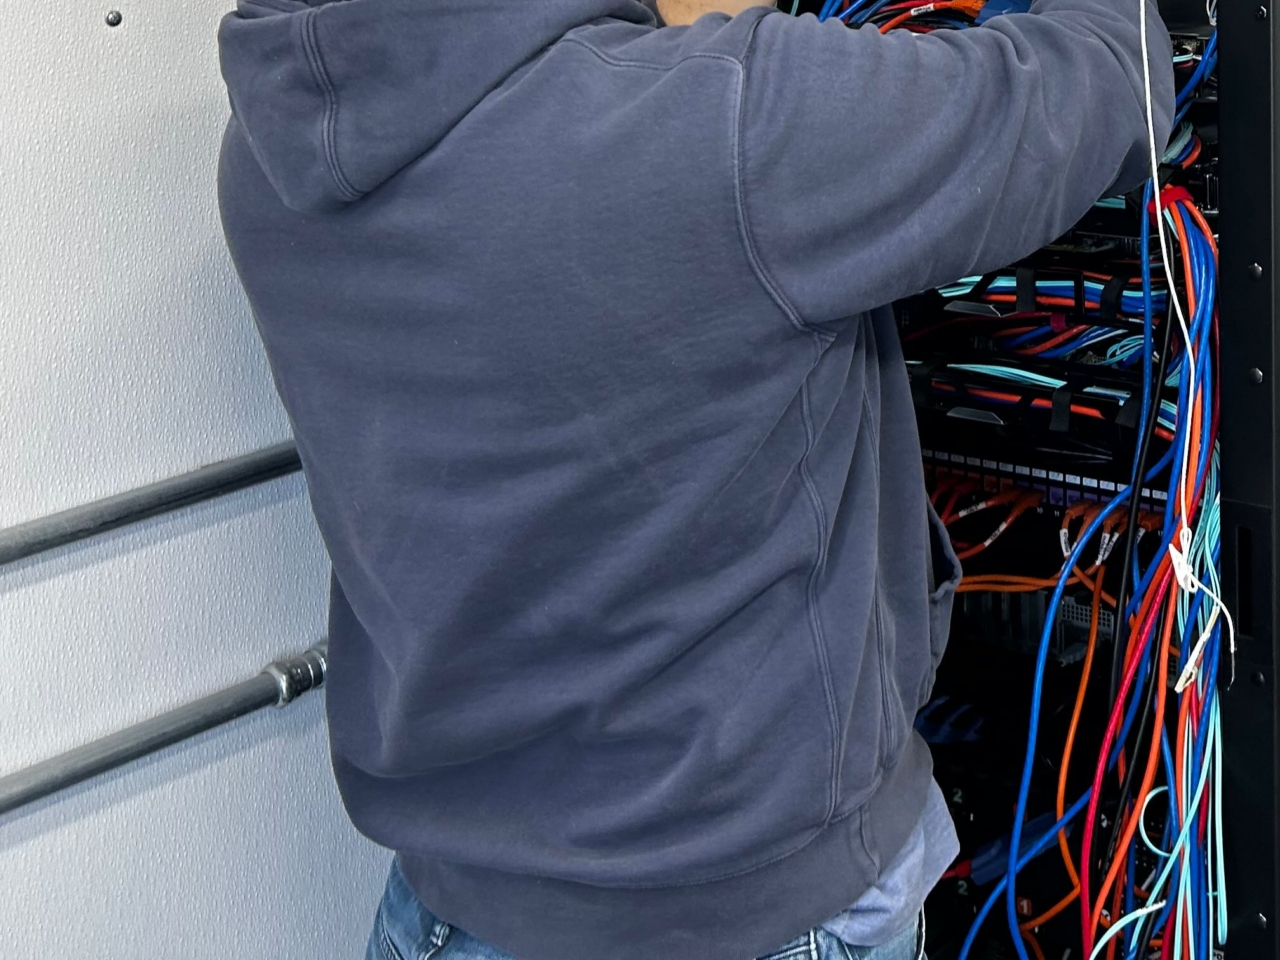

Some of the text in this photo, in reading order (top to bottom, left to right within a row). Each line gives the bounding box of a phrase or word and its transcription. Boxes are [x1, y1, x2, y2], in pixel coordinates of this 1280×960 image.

[952, 788, 963, 804] 2
[957, 880, 968, 896] 2
[1020, 900, 1028, 915] 1
